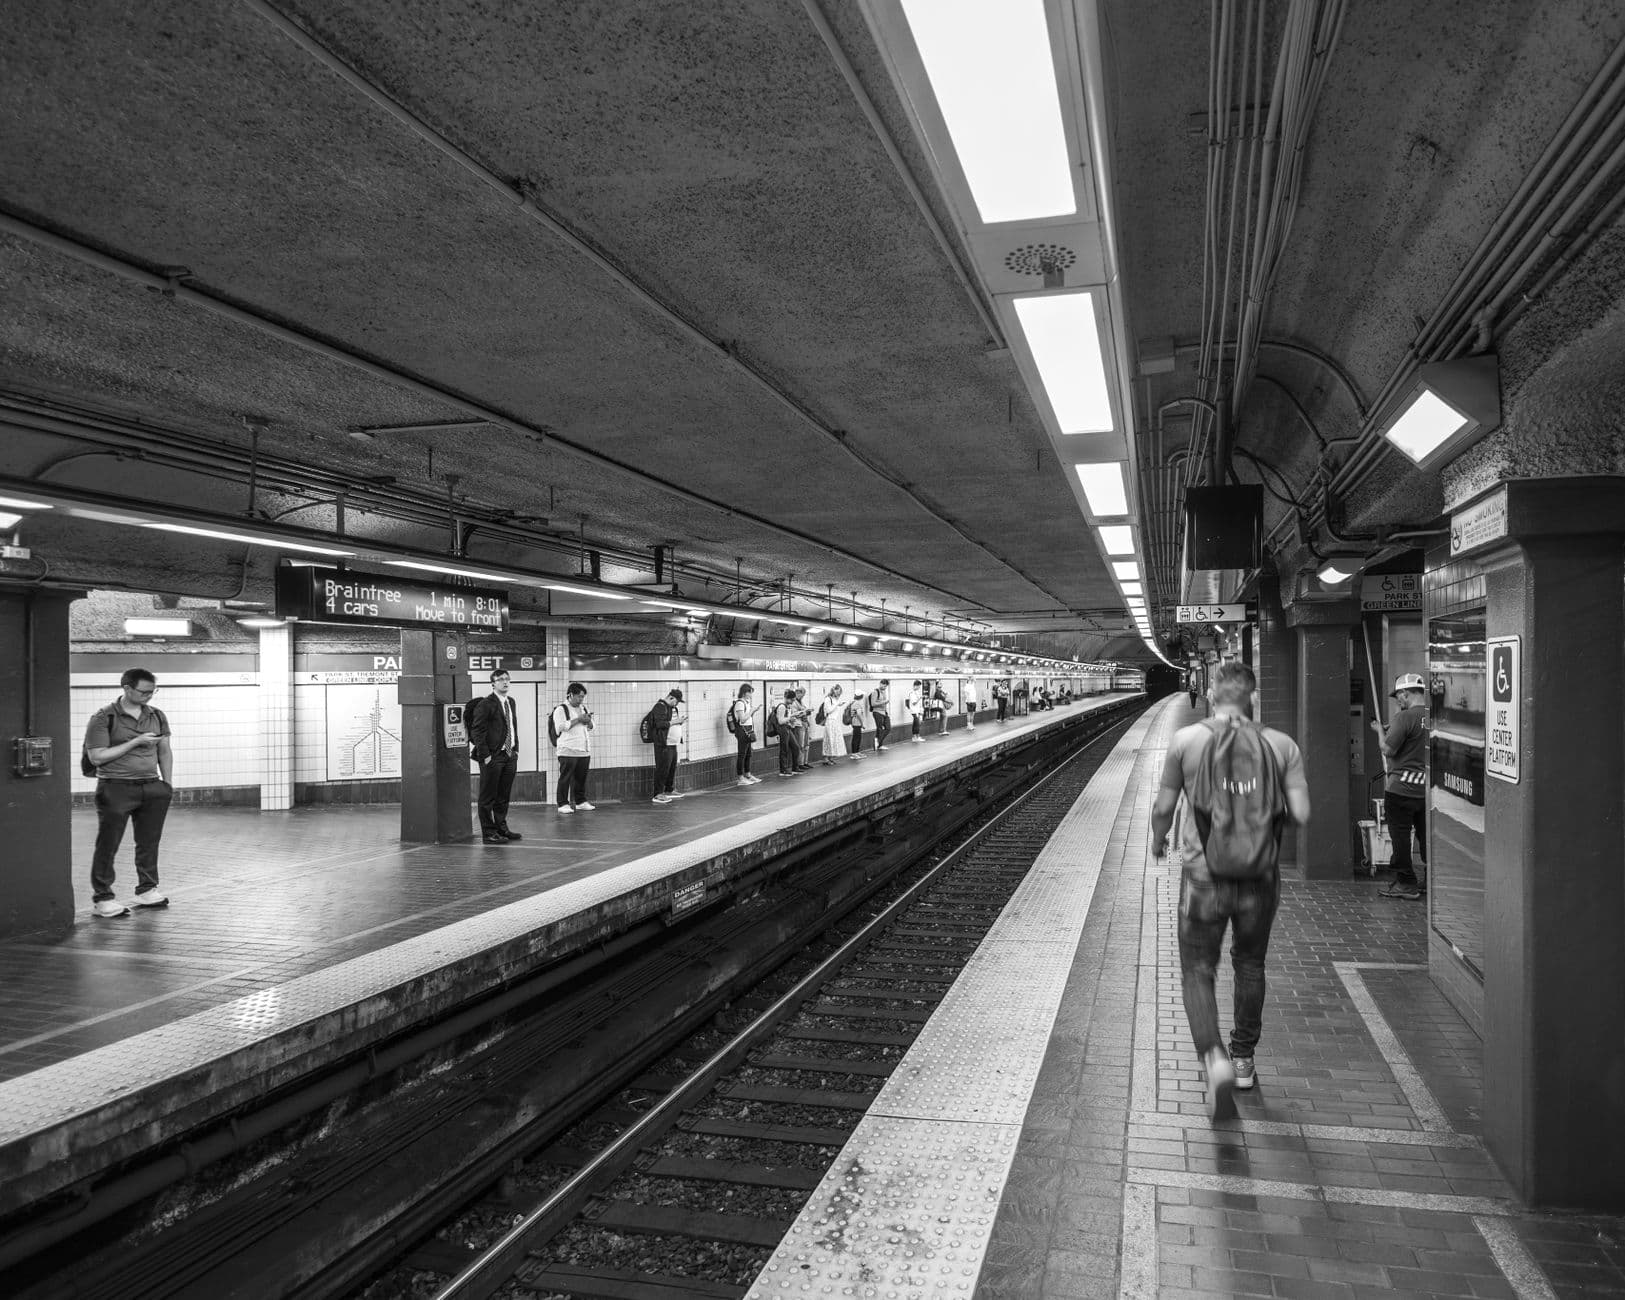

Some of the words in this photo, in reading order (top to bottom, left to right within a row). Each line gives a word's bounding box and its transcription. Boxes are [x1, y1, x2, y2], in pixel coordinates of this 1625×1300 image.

[325, 579, 401, 603] Braintree
[430, 591, 437, 607] 1
[443, 593, 465, 609] min
[475, 596, 501, 612] 8:01
[1384, 592, 1410, 600] PARK
[326, 597, 336, 613] 4
[343, 601, 379, 616] cars
[415, 605, 445, 621] Move
[451, 608, 465, 623] to
[471, 610, 501, 626] front
[1496, 710, 1508, 726] USE
[1493, 729, 1513, 747] CENTER
[1489, 747, 1516, 768] PLATFORM
[1444, 772, 1473, 797] SAMSUNG
[674, 881, 704, 898] DANGER
